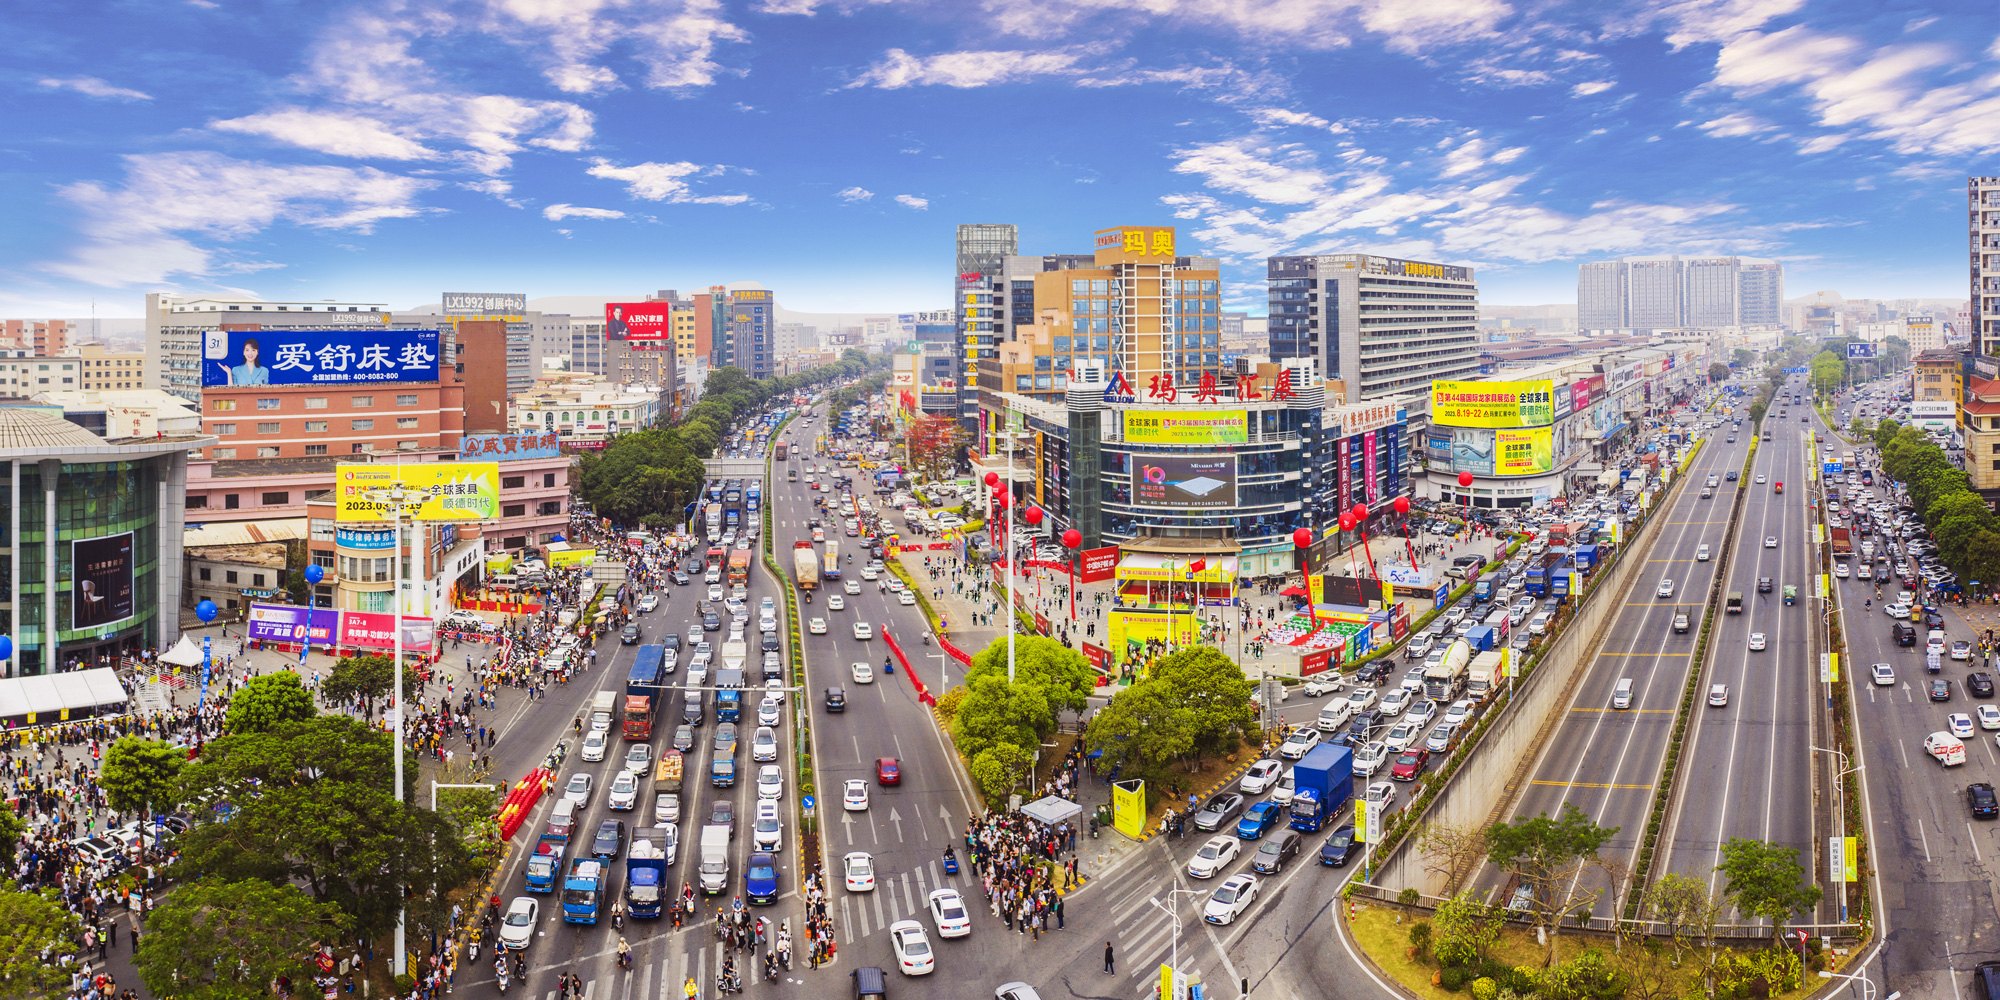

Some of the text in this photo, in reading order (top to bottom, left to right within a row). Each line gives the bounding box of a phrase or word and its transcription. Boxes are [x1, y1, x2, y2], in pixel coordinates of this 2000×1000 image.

[1124, 230, 1174, 256] 玛奥
[272, 342, 436, 372] 爱舒床垫
[1149, 368, 1298, 404] 玛奥汇展
[1445, 394, 1516, 402] 第44届国际龙家具展览会
[1520, 392, 1549, 403] 全球家具
[1520, 405, 1549, 416] 顺德时代
[1129, 418, 1158, 426] 全球家具
[1142, 464, 1166, 483] 10
[431, 484, 478, 495] 全球家具
[443, 498, 490, 509] 顺德时代
